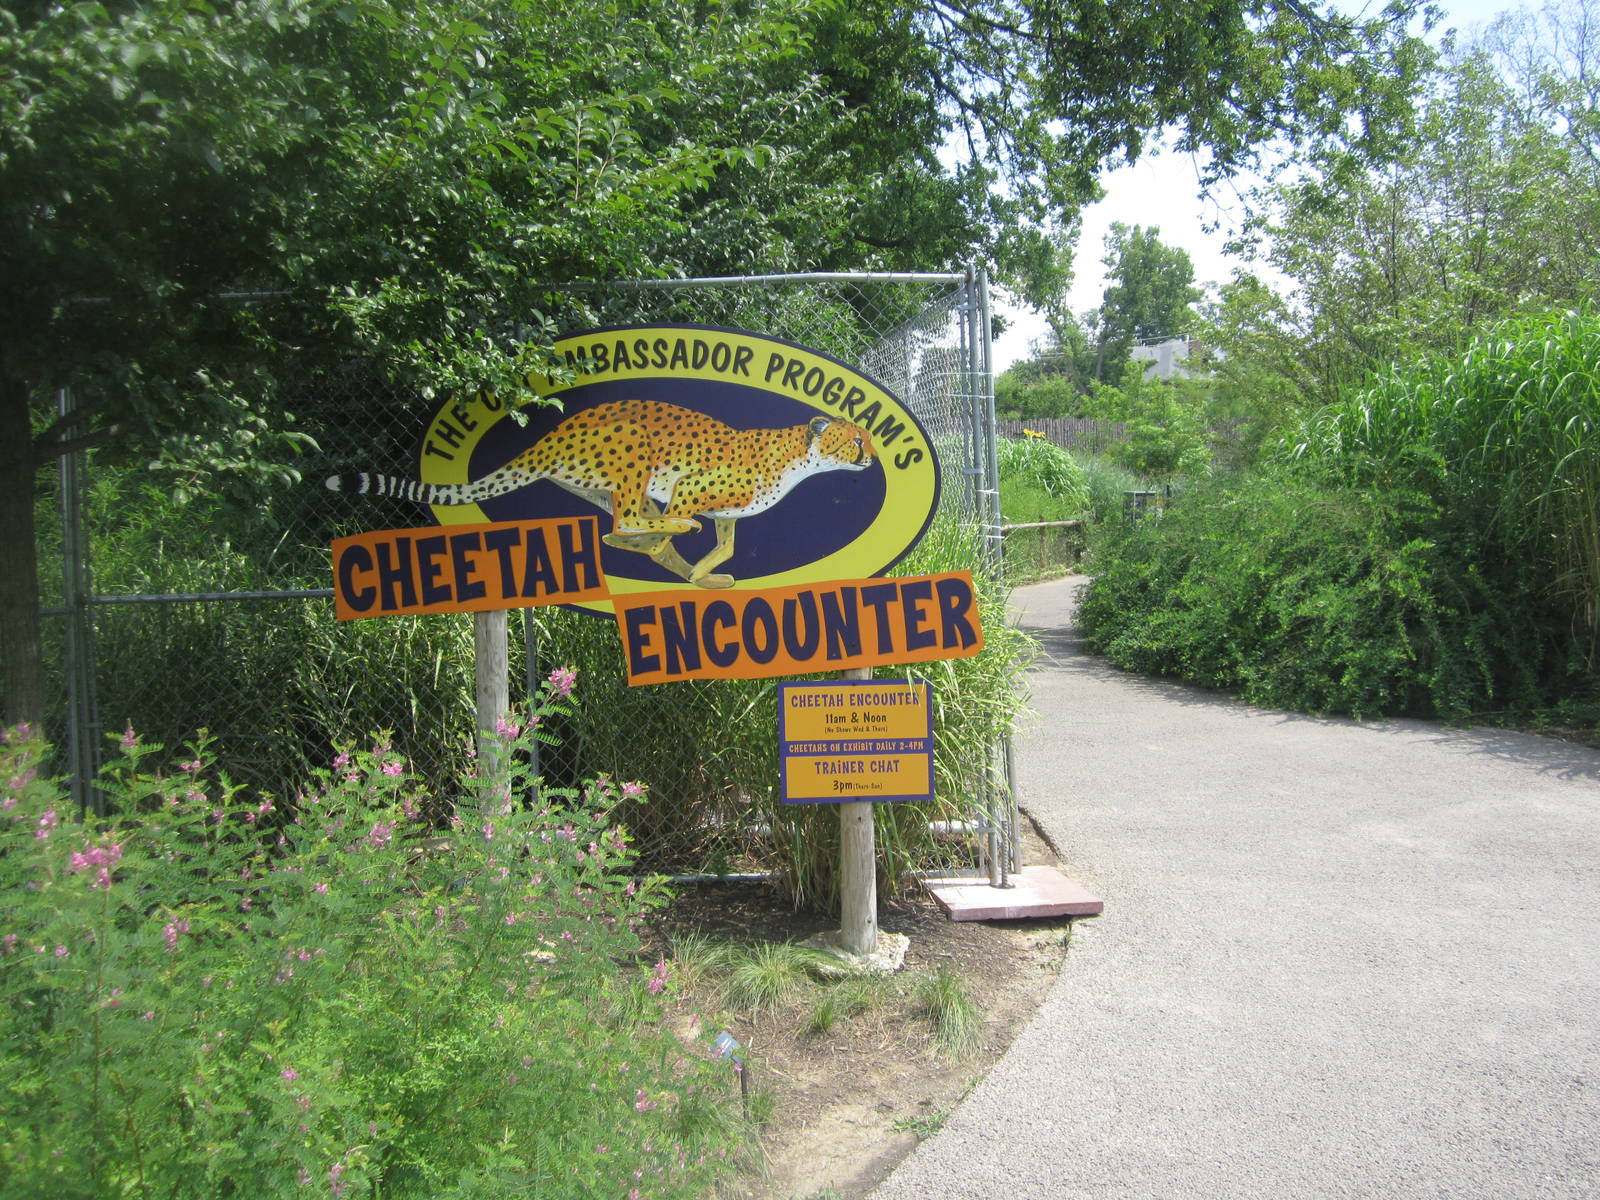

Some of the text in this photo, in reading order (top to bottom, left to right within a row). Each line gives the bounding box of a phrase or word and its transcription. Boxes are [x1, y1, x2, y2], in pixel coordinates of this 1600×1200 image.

[425, 404, 478, 461] THE
[765, 351, 923, 471] PROGRAM'S
[337, 520, 601, 612] CHEETAH
[624, 577, 978, 675] ENCOUNTER
[791, 693, 919, 707] CHEETAH ENCOUNTER
[826, 712, 886, 724] 11am & Noon
[789, 741, 923, 753] CHEETAHS ON EXHIBIT DAILY 2-4PM
[815, 760, 899, 774] TRAINER CHAT
